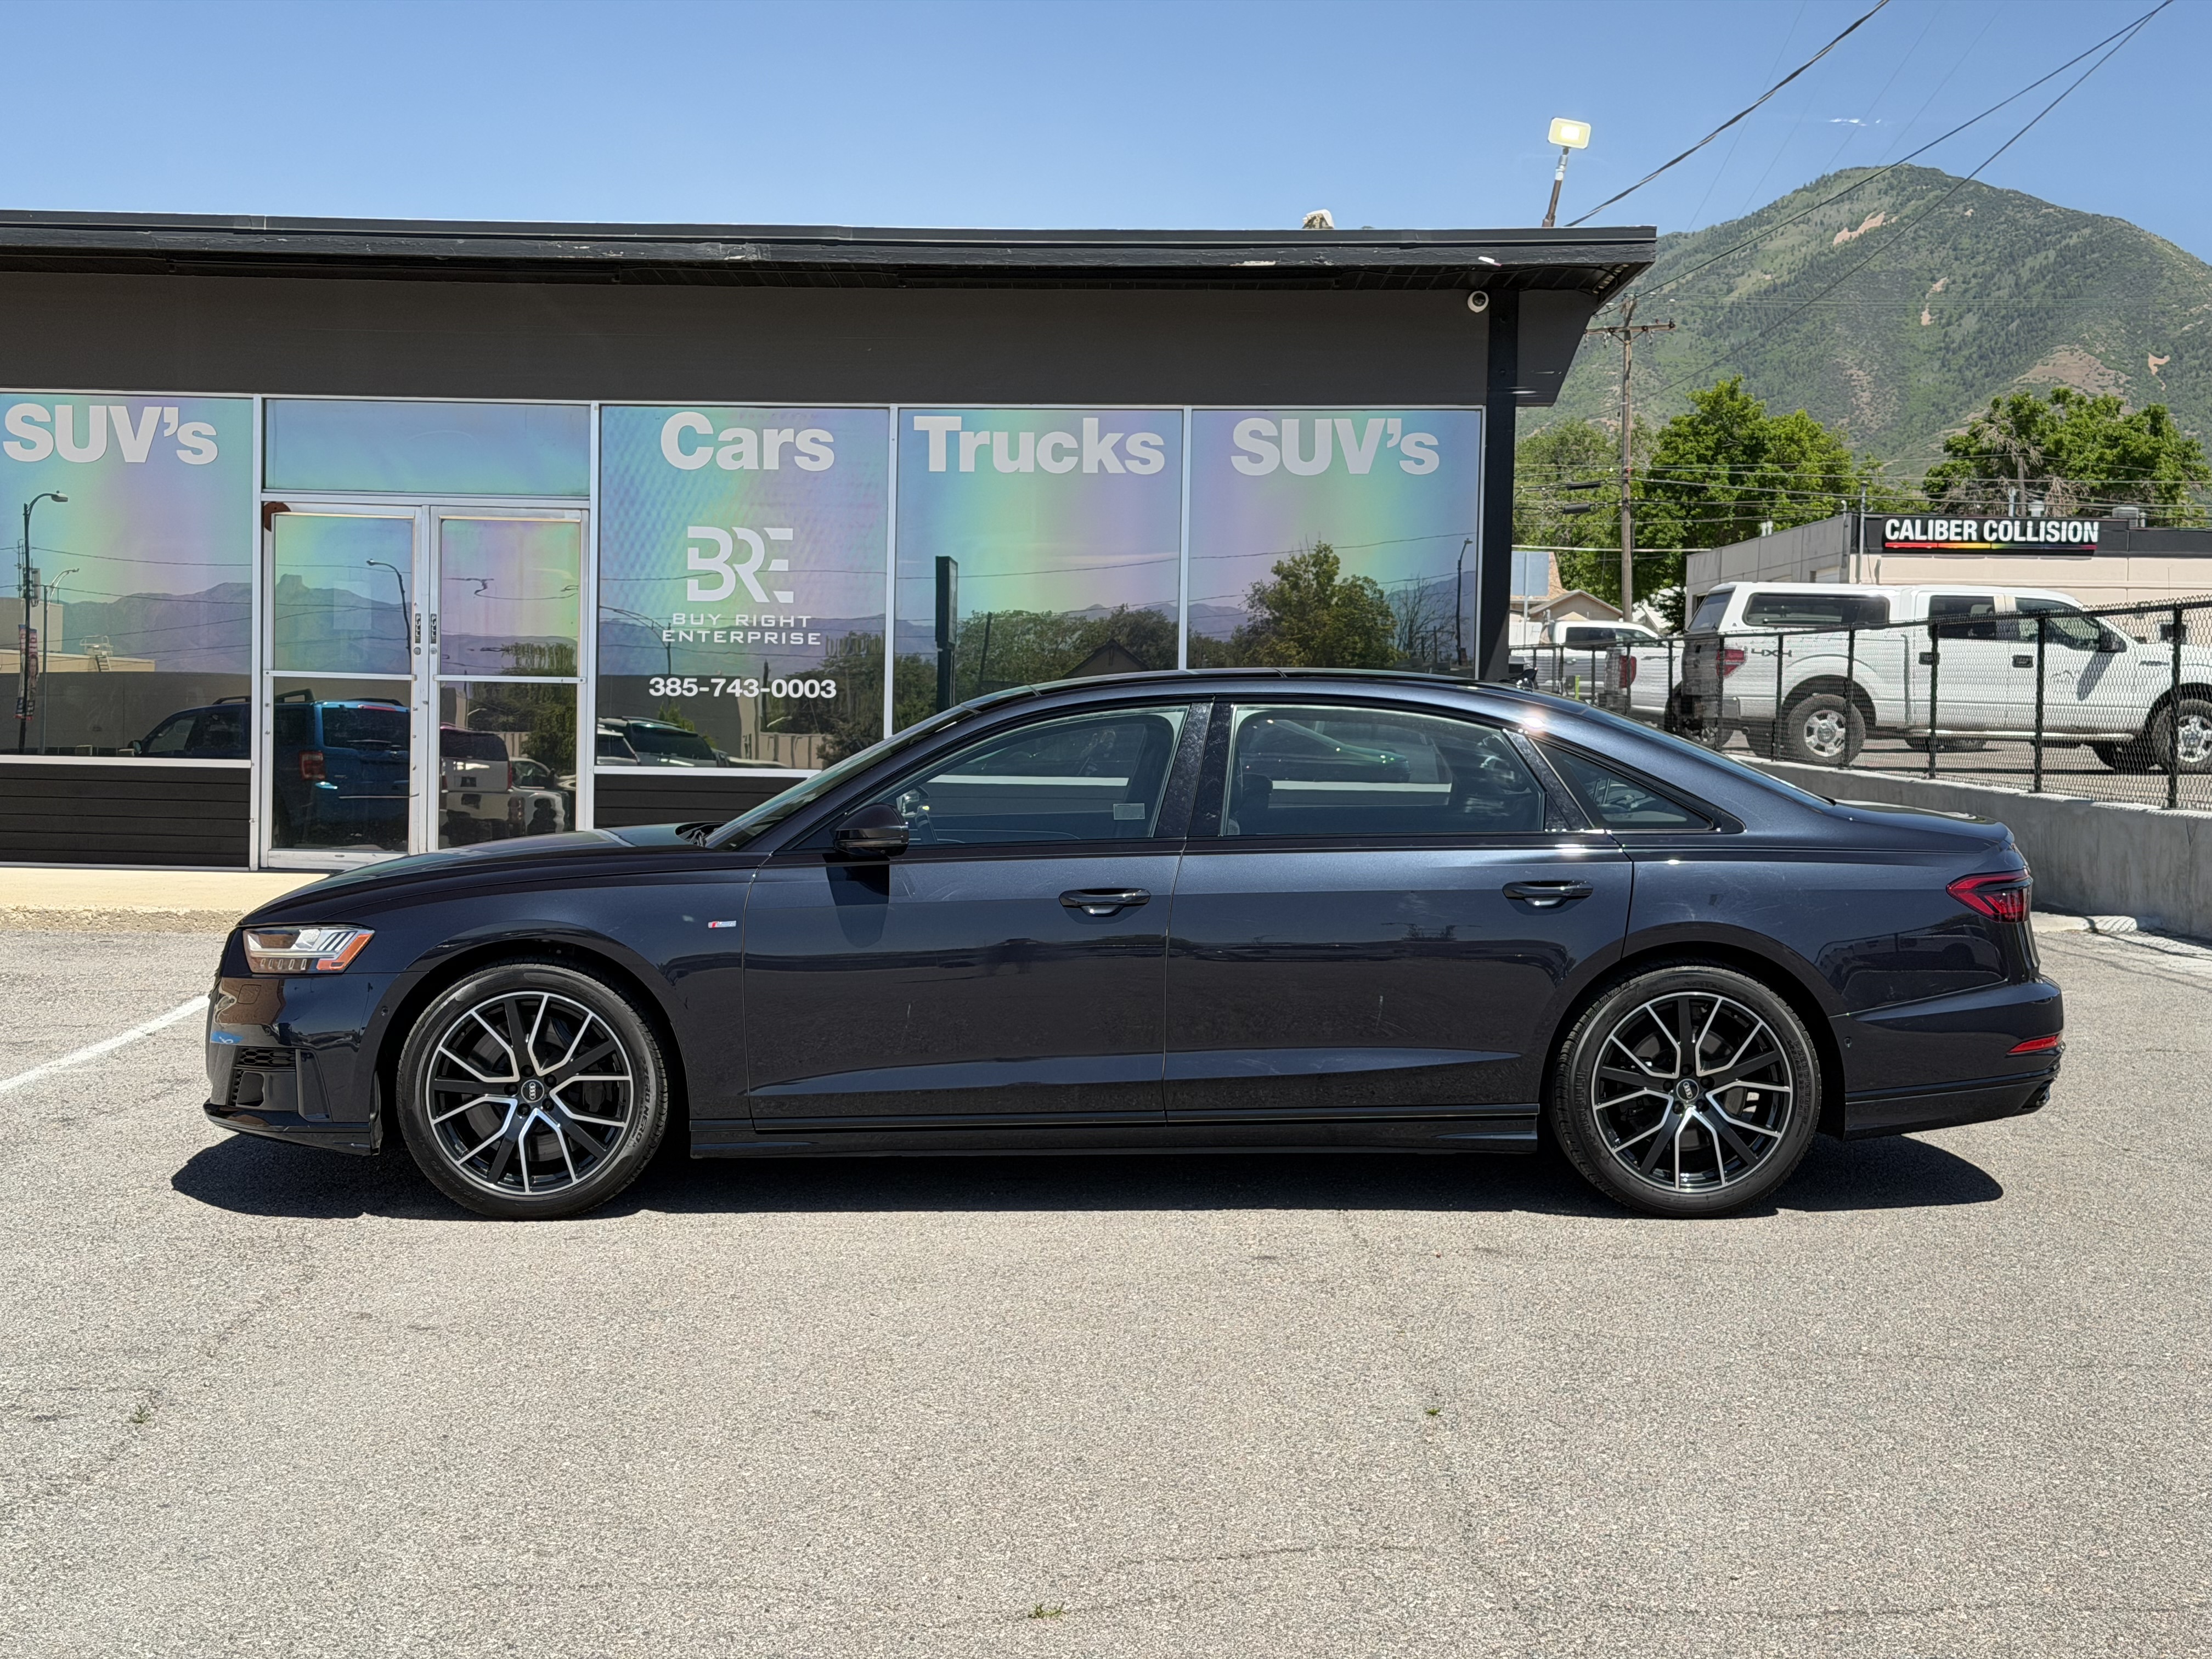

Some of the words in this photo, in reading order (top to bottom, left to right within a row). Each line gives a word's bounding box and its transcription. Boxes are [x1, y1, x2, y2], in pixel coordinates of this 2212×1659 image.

[3, 403, 218, 465] SUV's
[661, 411, 834, 471] Cars
[914, 416, 1165, 475] Trucks
[1231, 417, 1440, 476] SUV's
[1886, 519, 1977, 540] CALIBER
[1983, 520, 2098, 543] COLLISION
[686, 526, 794, 603] BRE
[662, 630, 821, 645] ENTERPRISE
[673, 613, 721, 626] BUY
[735, 614, 812, 628] RIGHT
[649, 678, 837, 698] 385-743-0003
